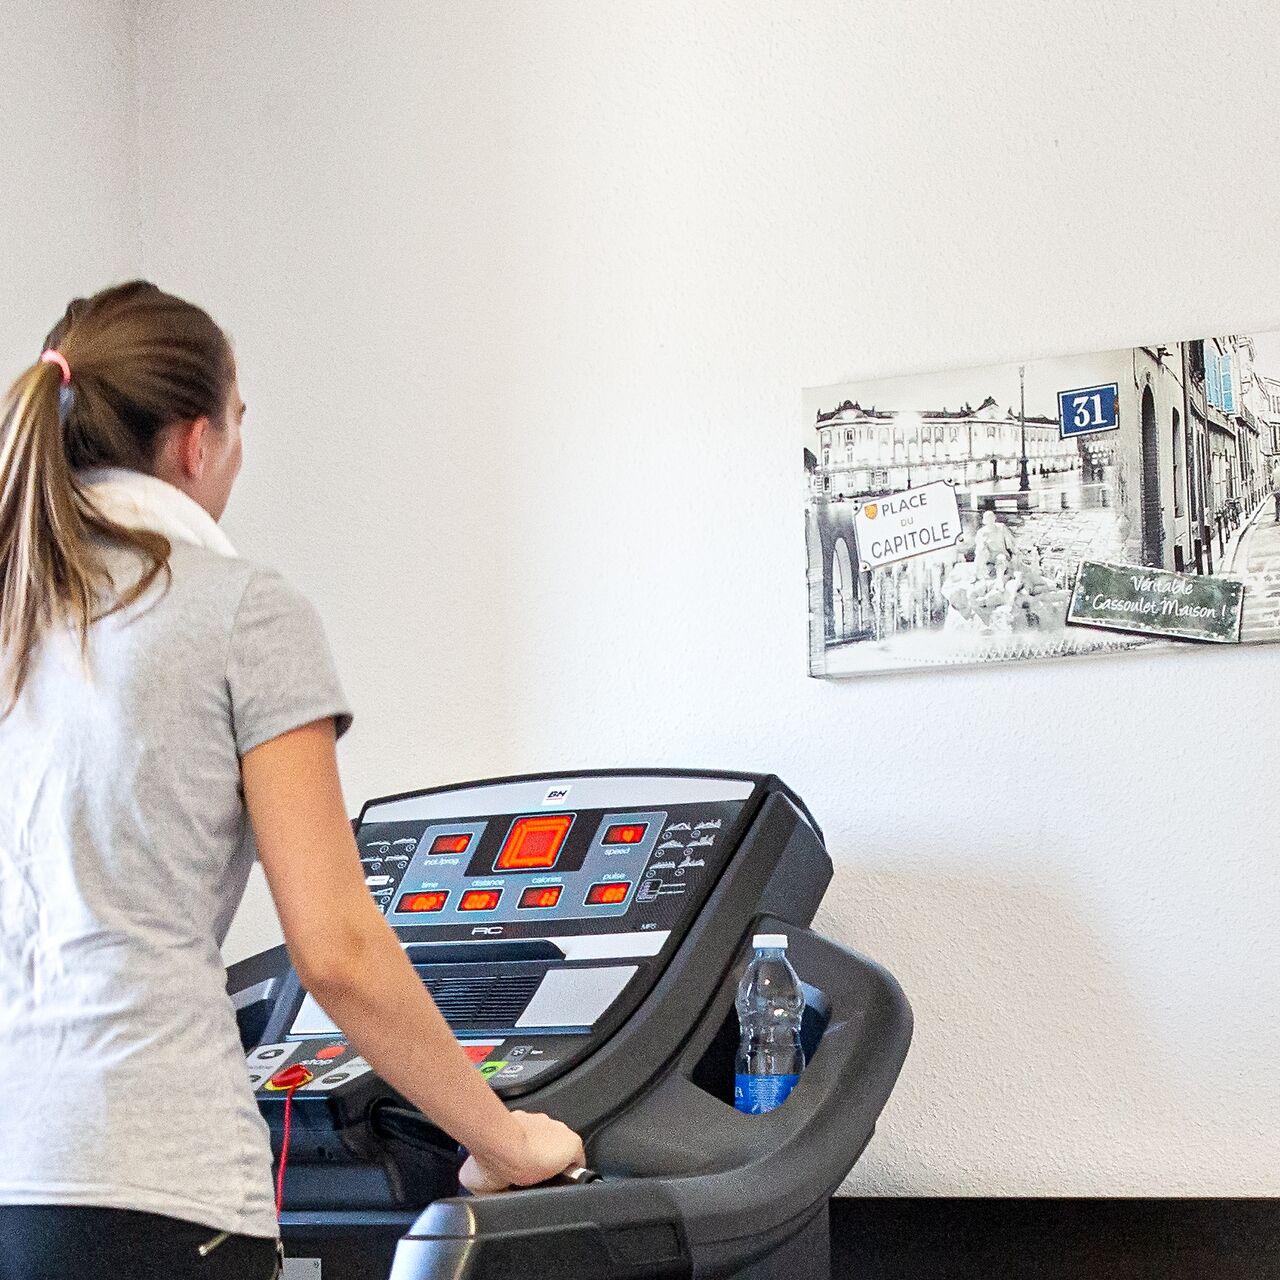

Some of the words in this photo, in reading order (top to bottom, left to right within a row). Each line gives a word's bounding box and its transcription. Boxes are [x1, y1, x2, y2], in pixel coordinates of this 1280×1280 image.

[1072, 394, 1108, 427] 31
[881, 493, 928, 517] PLACE
[900, 517, 914, 527] DU
[871, 522, 951, 559] CAPITOLE
[1093, 594, 1158, 614] Cassoulet
[1161, 597, 1216, 618] Maison
